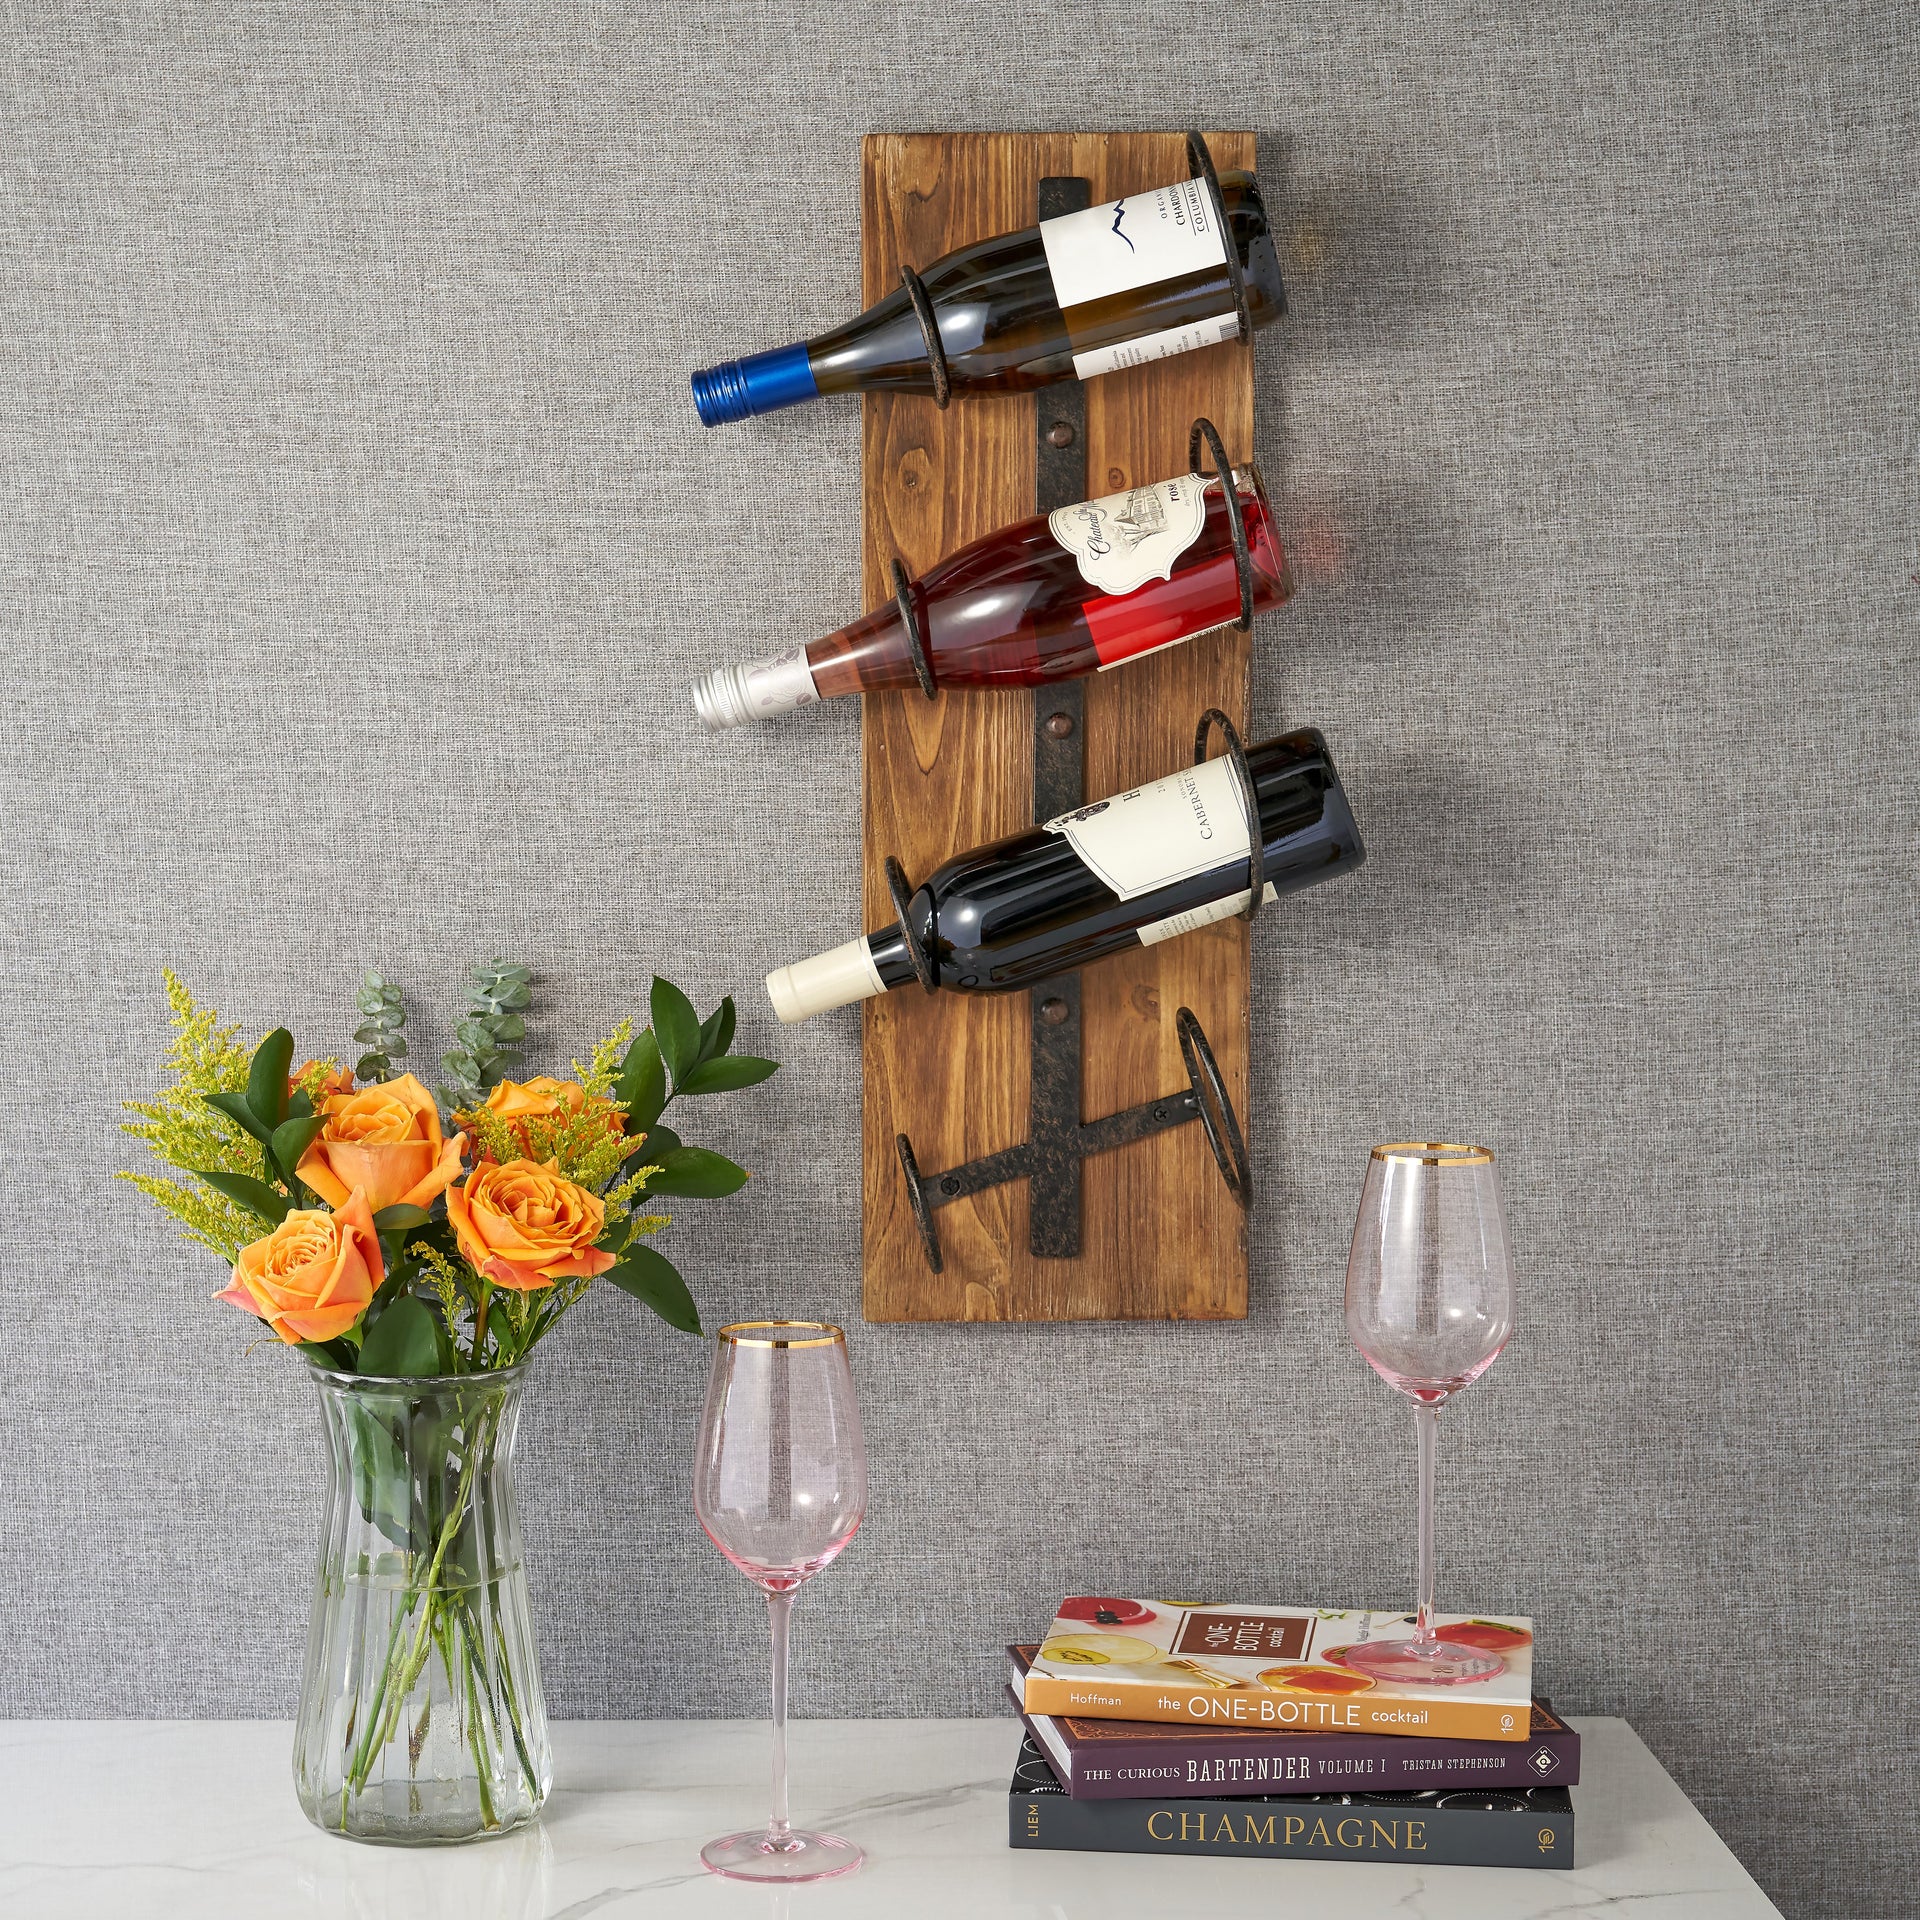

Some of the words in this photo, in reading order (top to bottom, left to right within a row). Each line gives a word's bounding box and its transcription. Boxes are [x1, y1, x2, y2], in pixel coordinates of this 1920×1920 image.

[1184, 777, 1213, 840] CABERNET
[1233, 1621, 1265, 1651] BOTTLE
[1265, 1627, 1285, 1648] cocktail
[1070, 1693, 1122, 1706] Hoffman
[1158, 1696, 1181, 1710] the
[1188, 1696, 1361, 1726] ONE-BOTTLE
[1371, 1709, 1428, 1724] cocktail
[1084, 1769, 1112, 1780] THE
[1117, 1767, 1180, 1780] CURIOUS
[1186, 1756, 1311, 1782] BARTENDER
[1318, 1760, 1374, 1774] VOLUME
[1381, 1758, 1386, 1773] I
[1402, 1760, 1443, 1771] TRISTAN
[1447, 1757, 1506, 1769] STEPHENSON
[1027, 1804, 1039, 1837] LIEM
[1147, 1811, 1428, 1850] CHAMPAGNE
